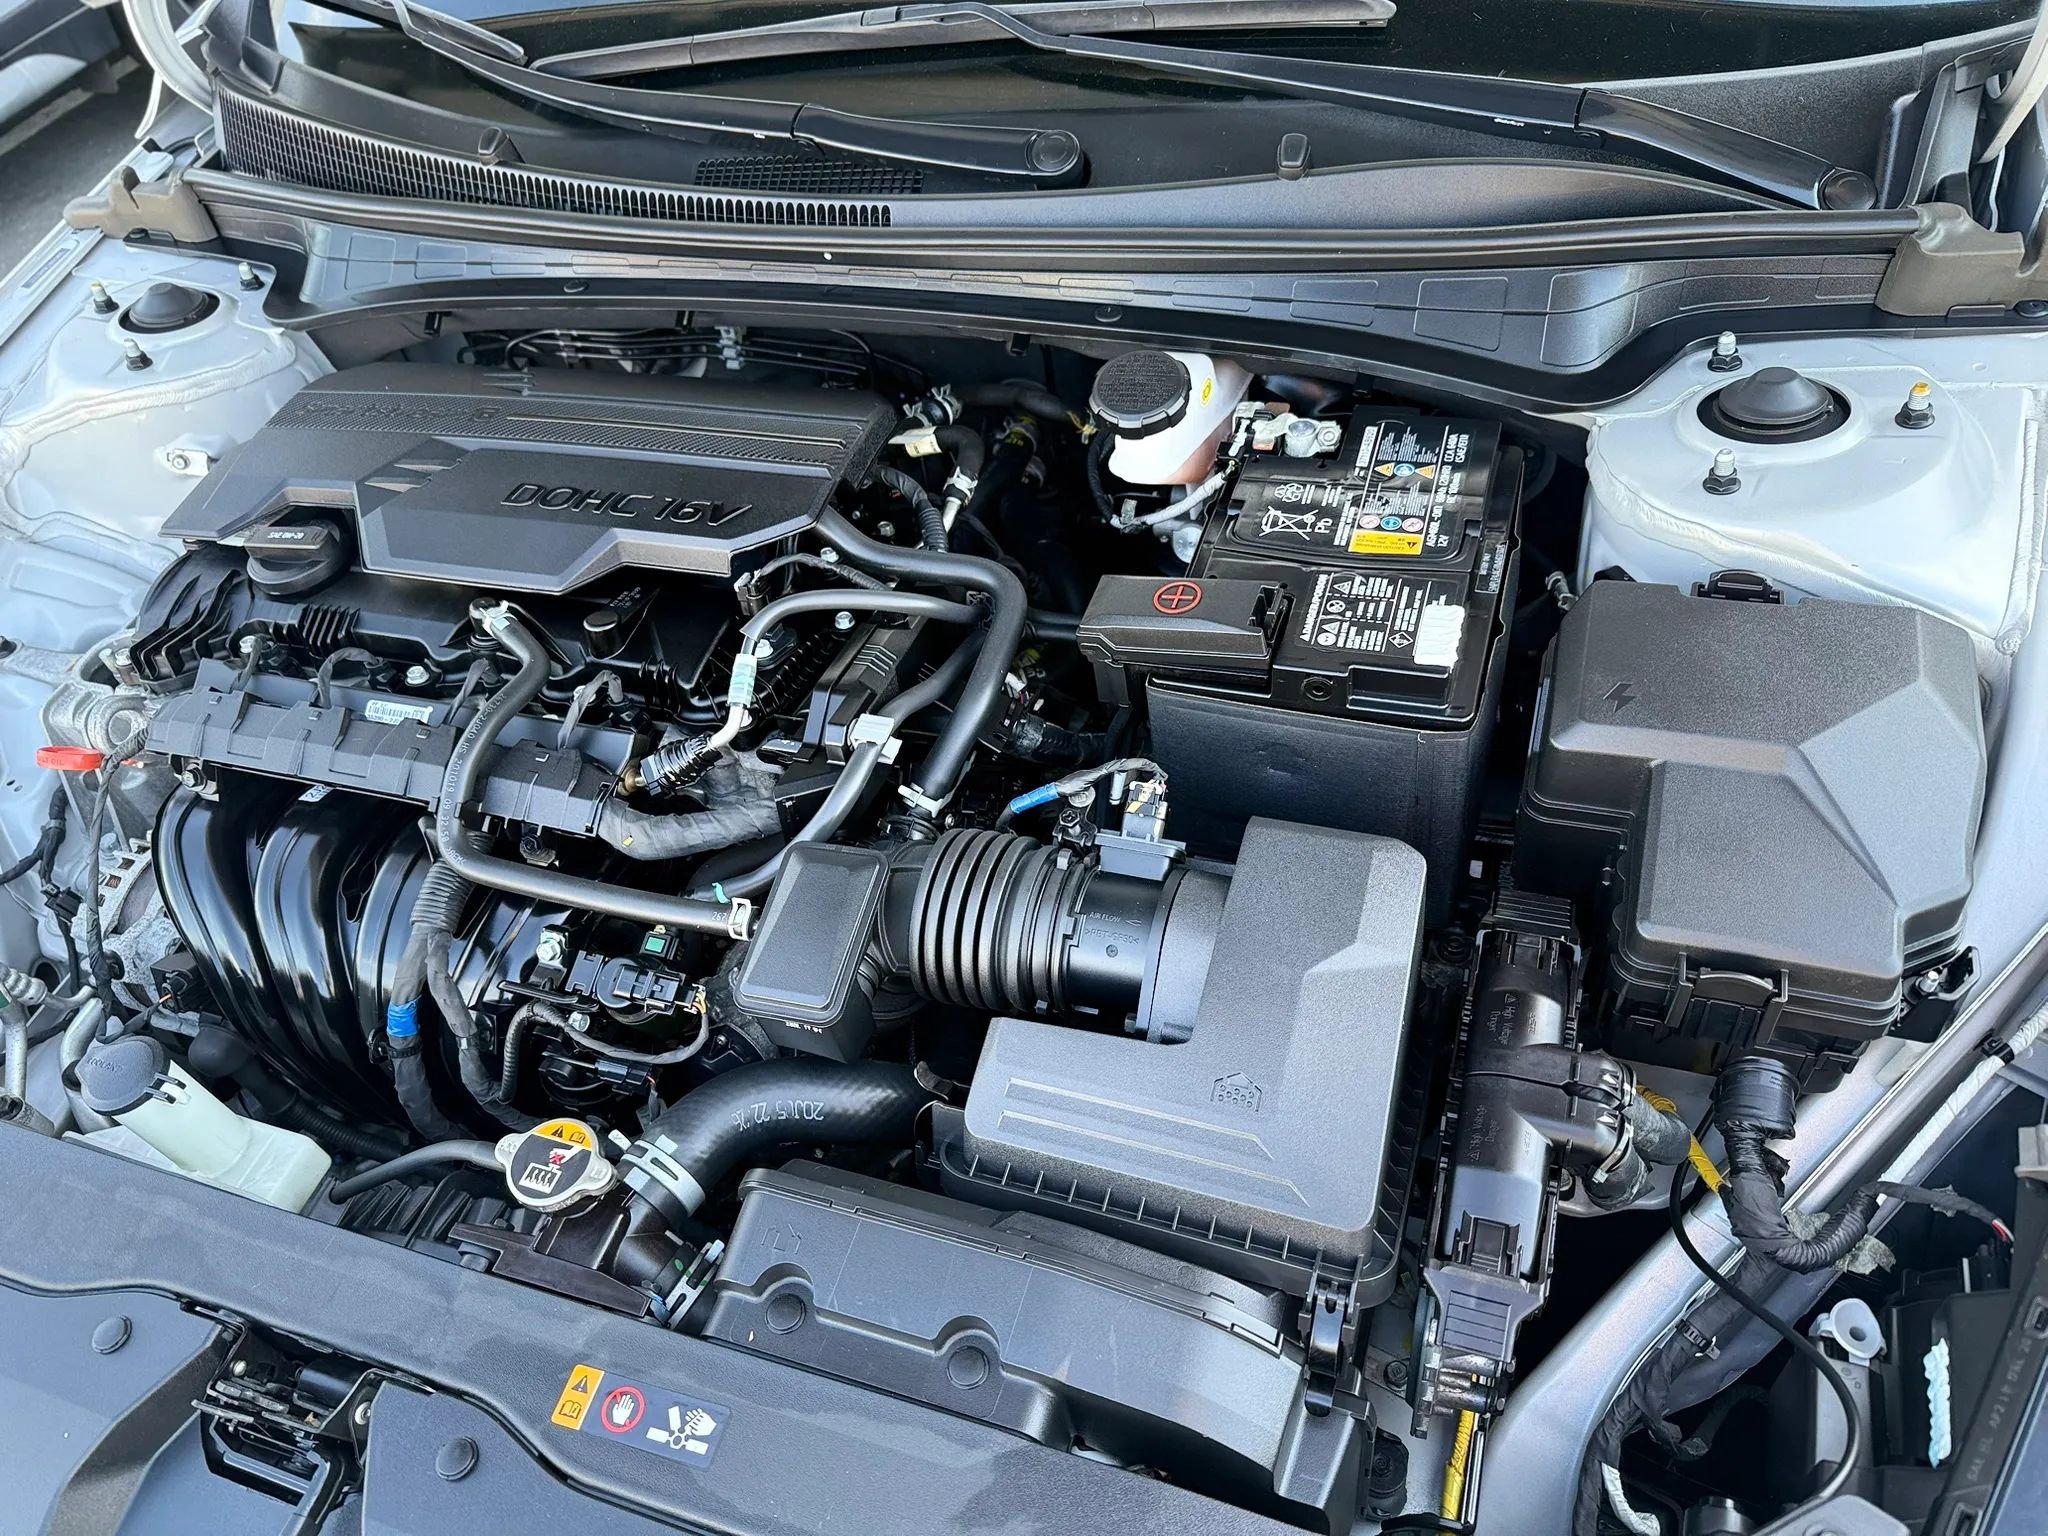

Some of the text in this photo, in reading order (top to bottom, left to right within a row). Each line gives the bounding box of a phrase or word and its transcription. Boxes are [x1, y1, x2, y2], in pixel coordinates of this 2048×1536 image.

[501, 482, 752, 526] DOHC 16V
[1315, 518, 1333, 533] Pb
[1437, 534, 1449, 548] 12V
[1102, 914, 1121, 922] FLOW
